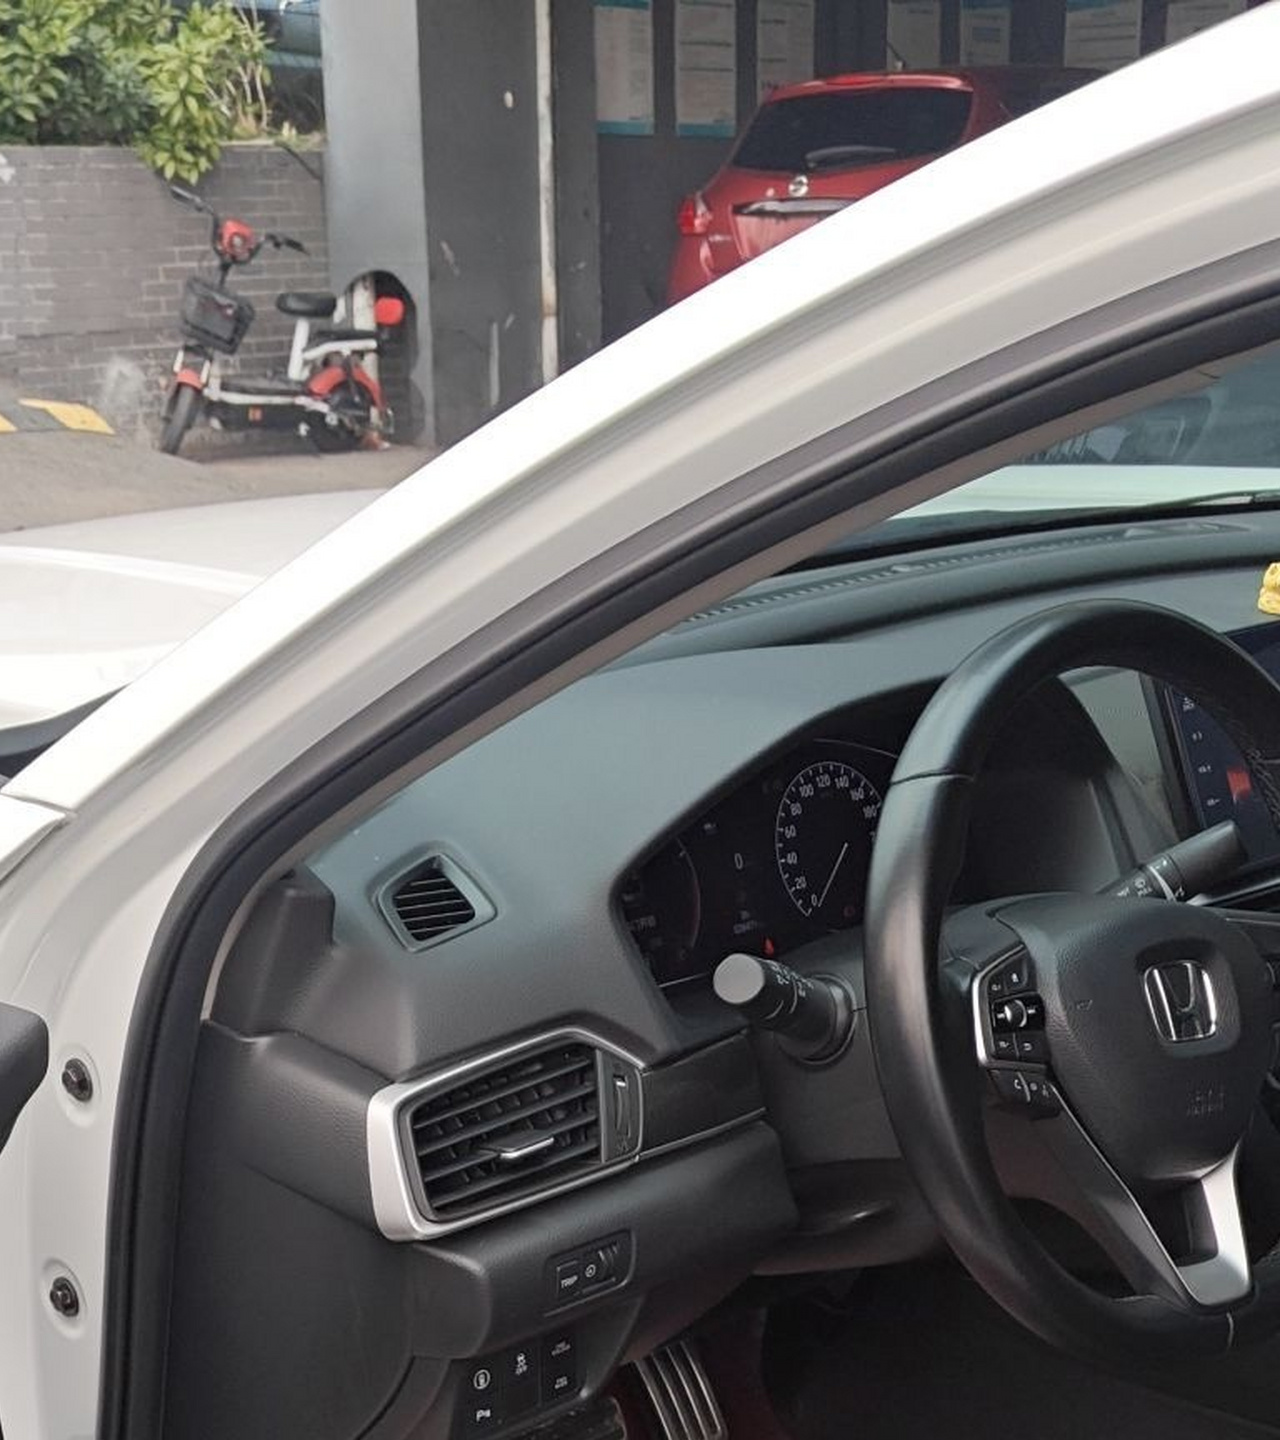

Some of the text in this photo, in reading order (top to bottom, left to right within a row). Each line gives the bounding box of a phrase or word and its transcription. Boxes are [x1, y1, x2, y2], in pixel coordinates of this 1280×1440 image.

[816, 774, 831, 788] 120
[835, 775, 849, 789] 140
[799, 784, 814, 798] 100
[850, 787, 865, 801] 160
[790, 802, 803, 816] 80
[784, 825, 797, 839] 60
[786, 852, 798, 865] 40
[794, 876, 807, 889] 20
[811, 894, 818, 906] 0
